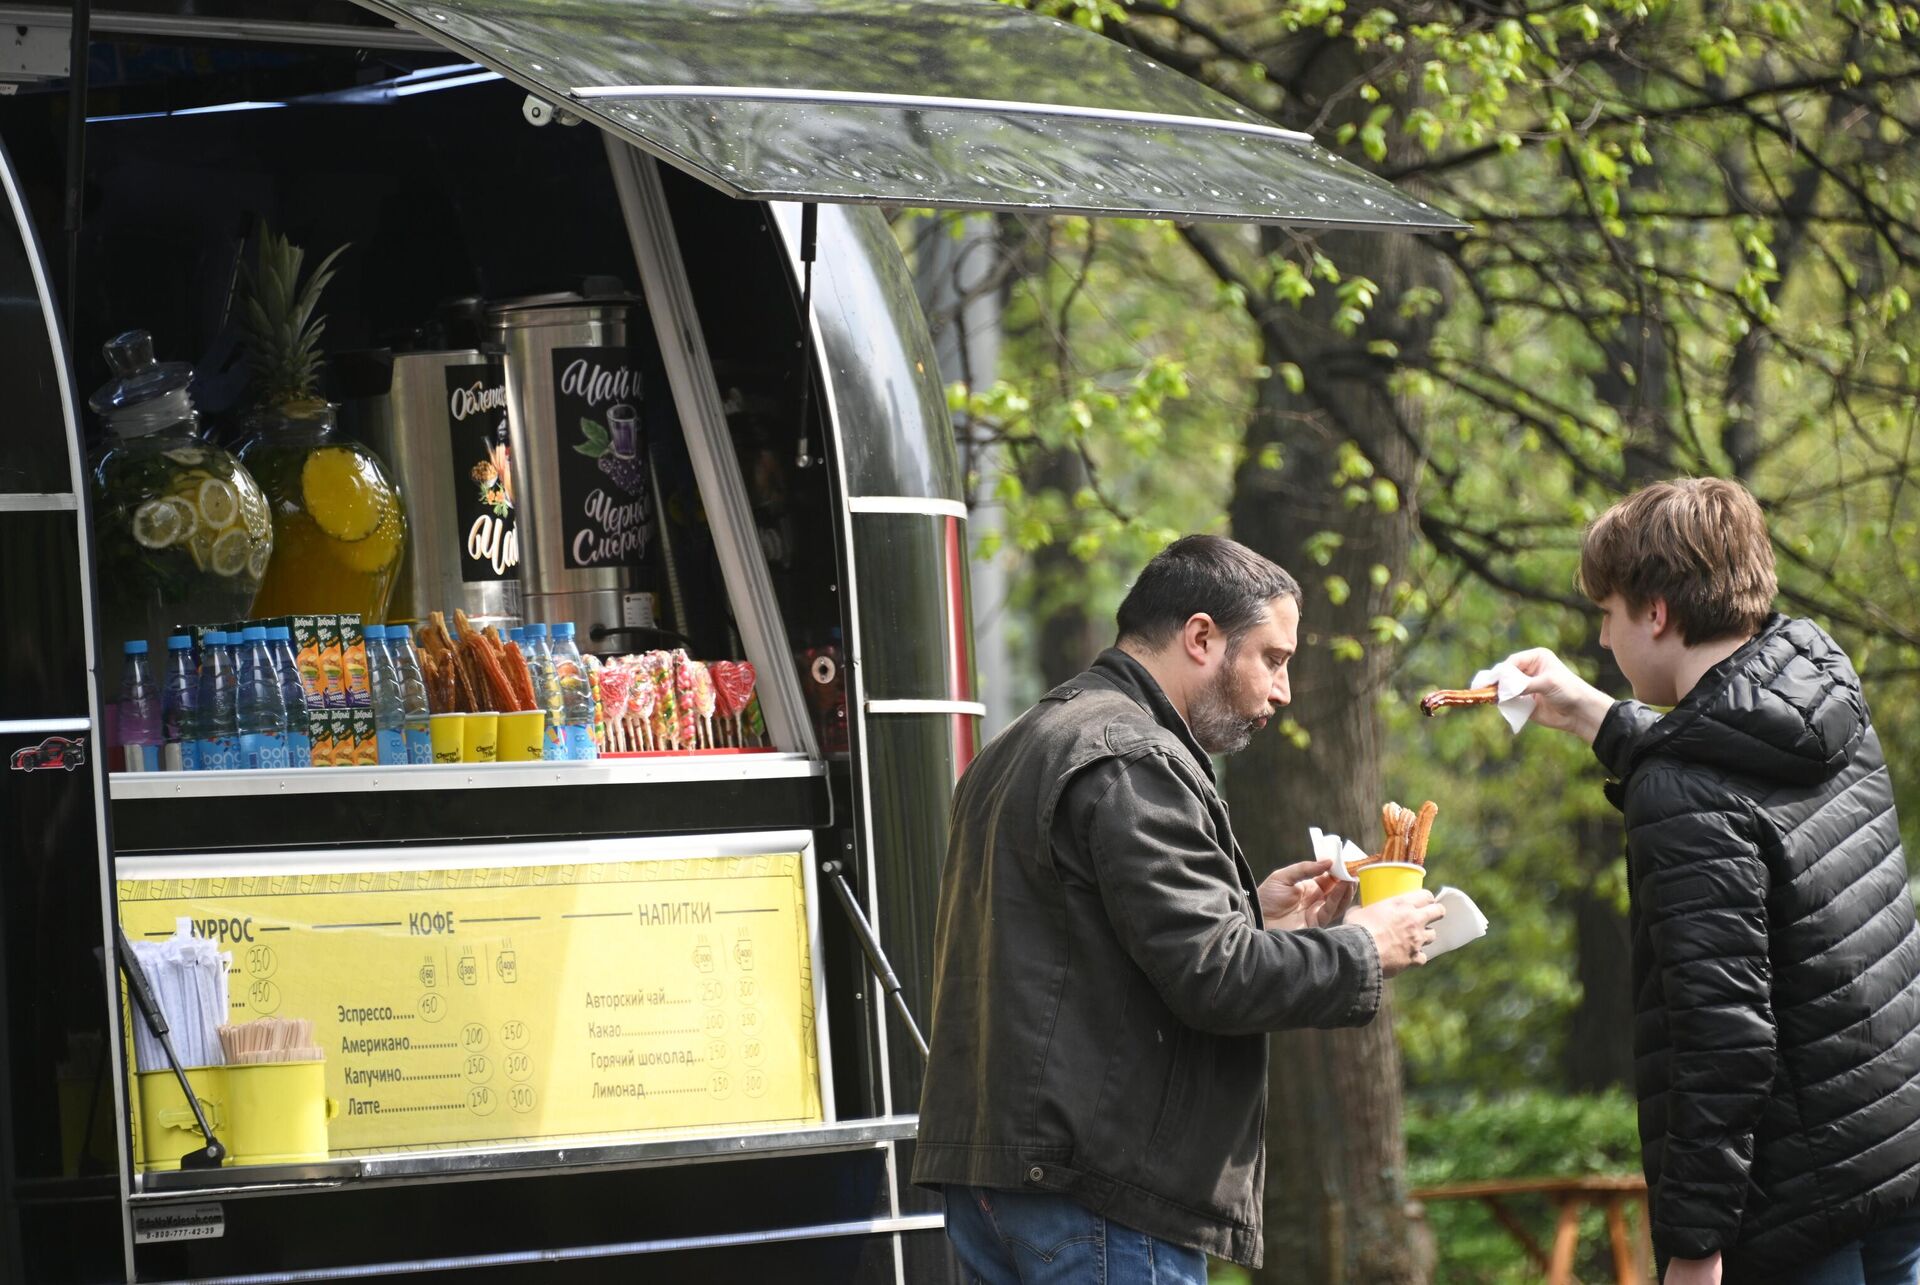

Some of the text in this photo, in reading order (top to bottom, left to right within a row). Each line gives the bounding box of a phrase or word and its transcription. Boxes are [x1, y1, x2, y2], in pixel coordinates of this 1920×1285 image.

[561, 359, 629, 406] Чай
[409, 911, 455, 935] КОФЕ
[638, 902, 712, 926] НАПИТКИ
[250, 948, 270, 973] 350
[252, 981, 270, 1003] 450
[421, 996, 438, 1014] 150
[508, 1056, 528, 1074] 300
[511, 1088, 533, 1108] 300
